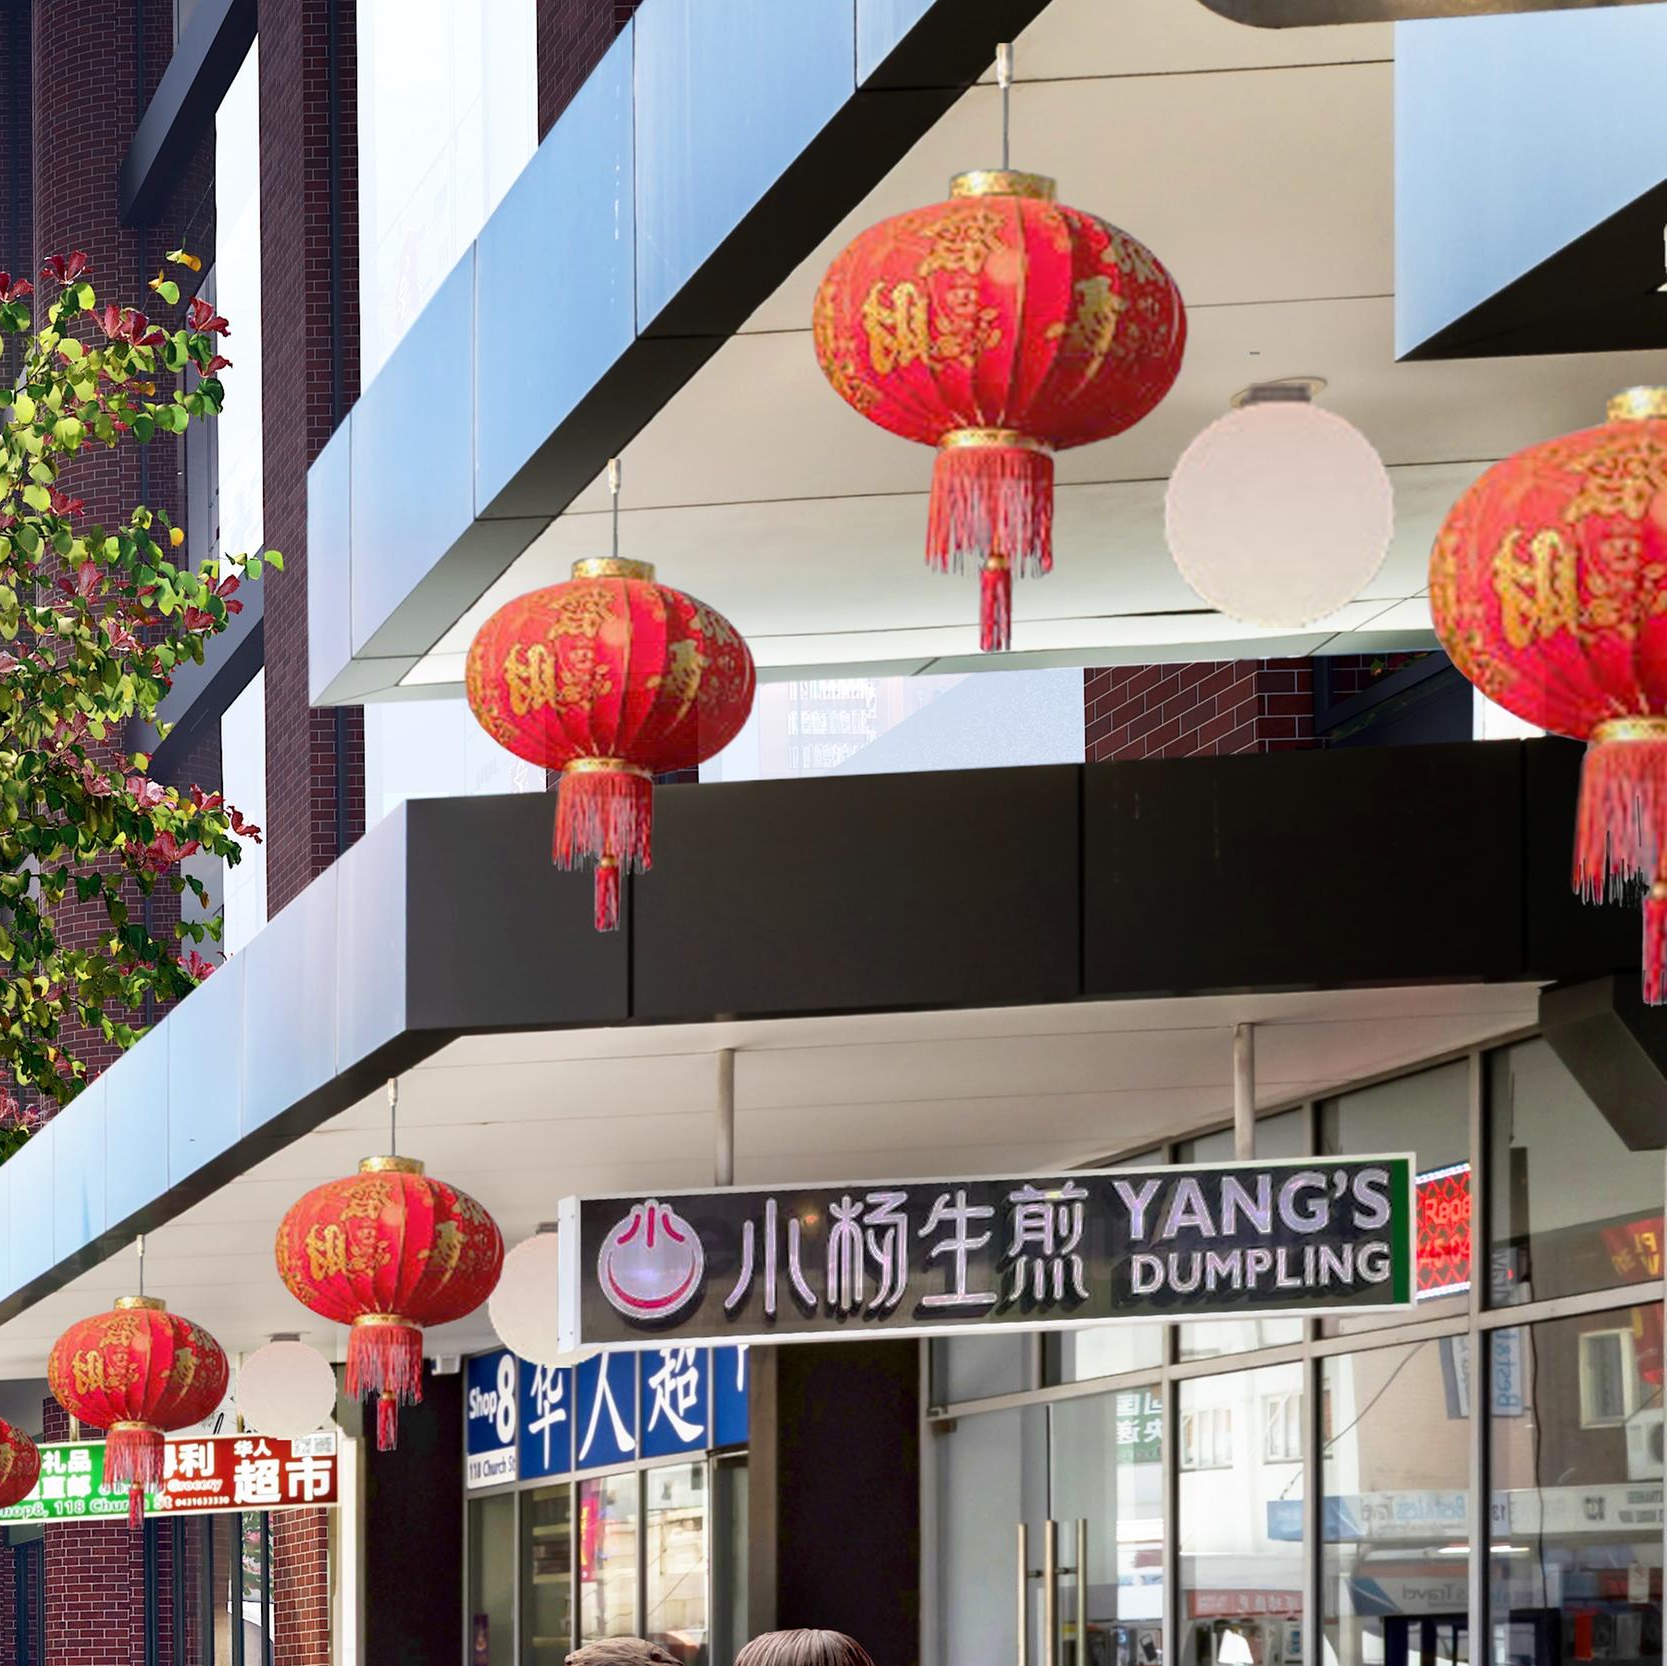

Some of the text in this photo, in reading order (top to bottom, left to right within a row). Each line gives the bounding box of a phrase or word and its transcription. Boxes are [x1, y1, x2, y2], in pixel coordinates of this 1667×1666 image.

[1112, 1167, 1392, 1240] YANG'S
[723, 1182, 1089, 1314] 小杨生煎
[1130, 1244, 1391, 1295] DUMPLING
[469, 1353, 516, 1444] Shop 8
[528, 1345, 749, 1471] 华人超
[233, 1438, 273, 1458] 华人
[469, 1459, 483, 1481] 118
[483, 1453, 507, 1479] Church
[53, 1500, 86, 1515] 118
[89, 1497, 149, 1513] Churh
[233, 1456, 333, 1505] 超市
